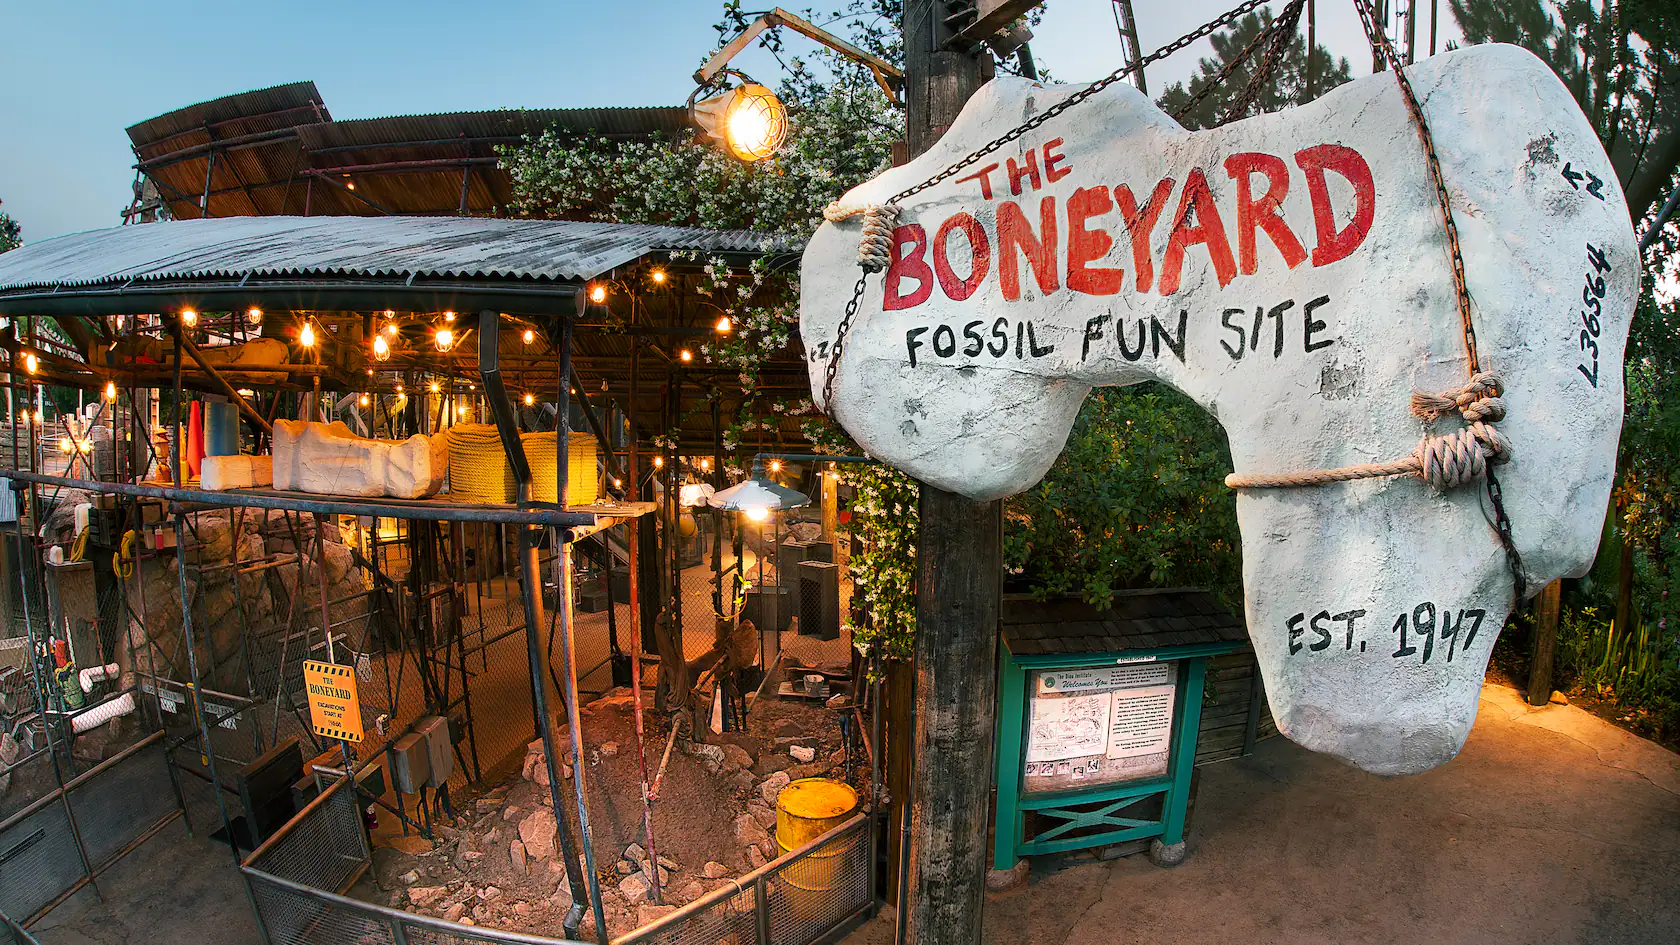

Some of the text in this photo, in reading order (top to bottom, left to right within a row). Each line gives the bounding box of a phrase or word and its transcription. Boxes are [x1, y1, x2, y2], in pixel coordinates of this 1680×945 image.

[955, 137, 1073, 200] THE
[882, 143, 1376, 311] BONEYARD
[906, 294, 1334, 368] FOSSIL FUN SITE
[1577, 242, 1613, 389] L36564
[1286, 601, 1486, 665] EST. 1947
[310, 683, 351, 700] BONEYARD
[323, 677, 334, 686] THE
[1062, 677, 1108, 688] Welcomes You
